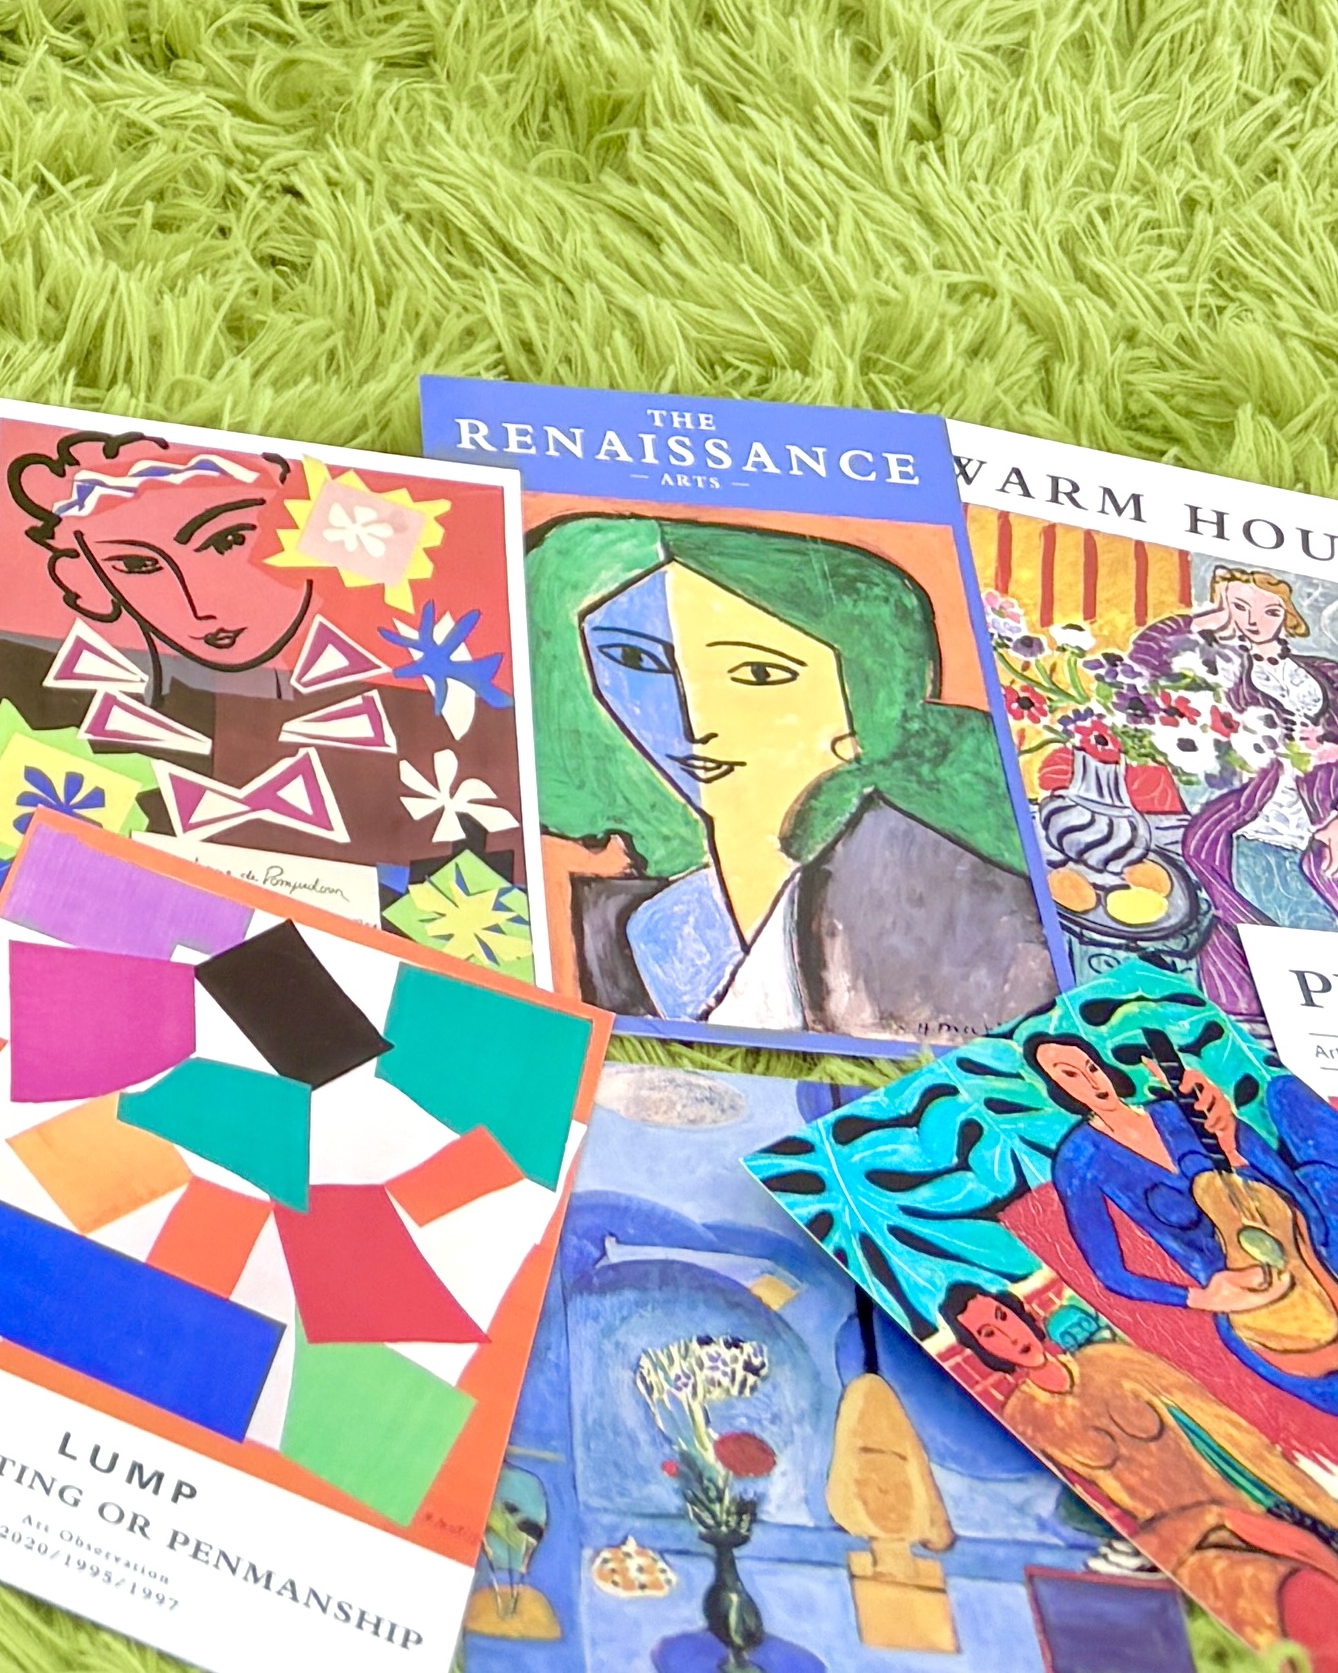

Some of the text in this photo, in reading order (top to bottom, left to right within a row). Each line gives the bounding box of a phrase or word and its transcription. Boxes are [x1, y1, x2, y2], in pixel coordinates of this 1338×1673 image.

[454, 417, 920, 486] RENAISSANCE
[647, 407, 717, 431] THE
[660, 472, 721, 490] ARTS
[953, 455, 1147, 523] WARM
[57, 1431, 199, 1504] LUMP
[98, 1501, 152, 1541] OR
[166, 1527, 424, 1652] PENMANSHIP
